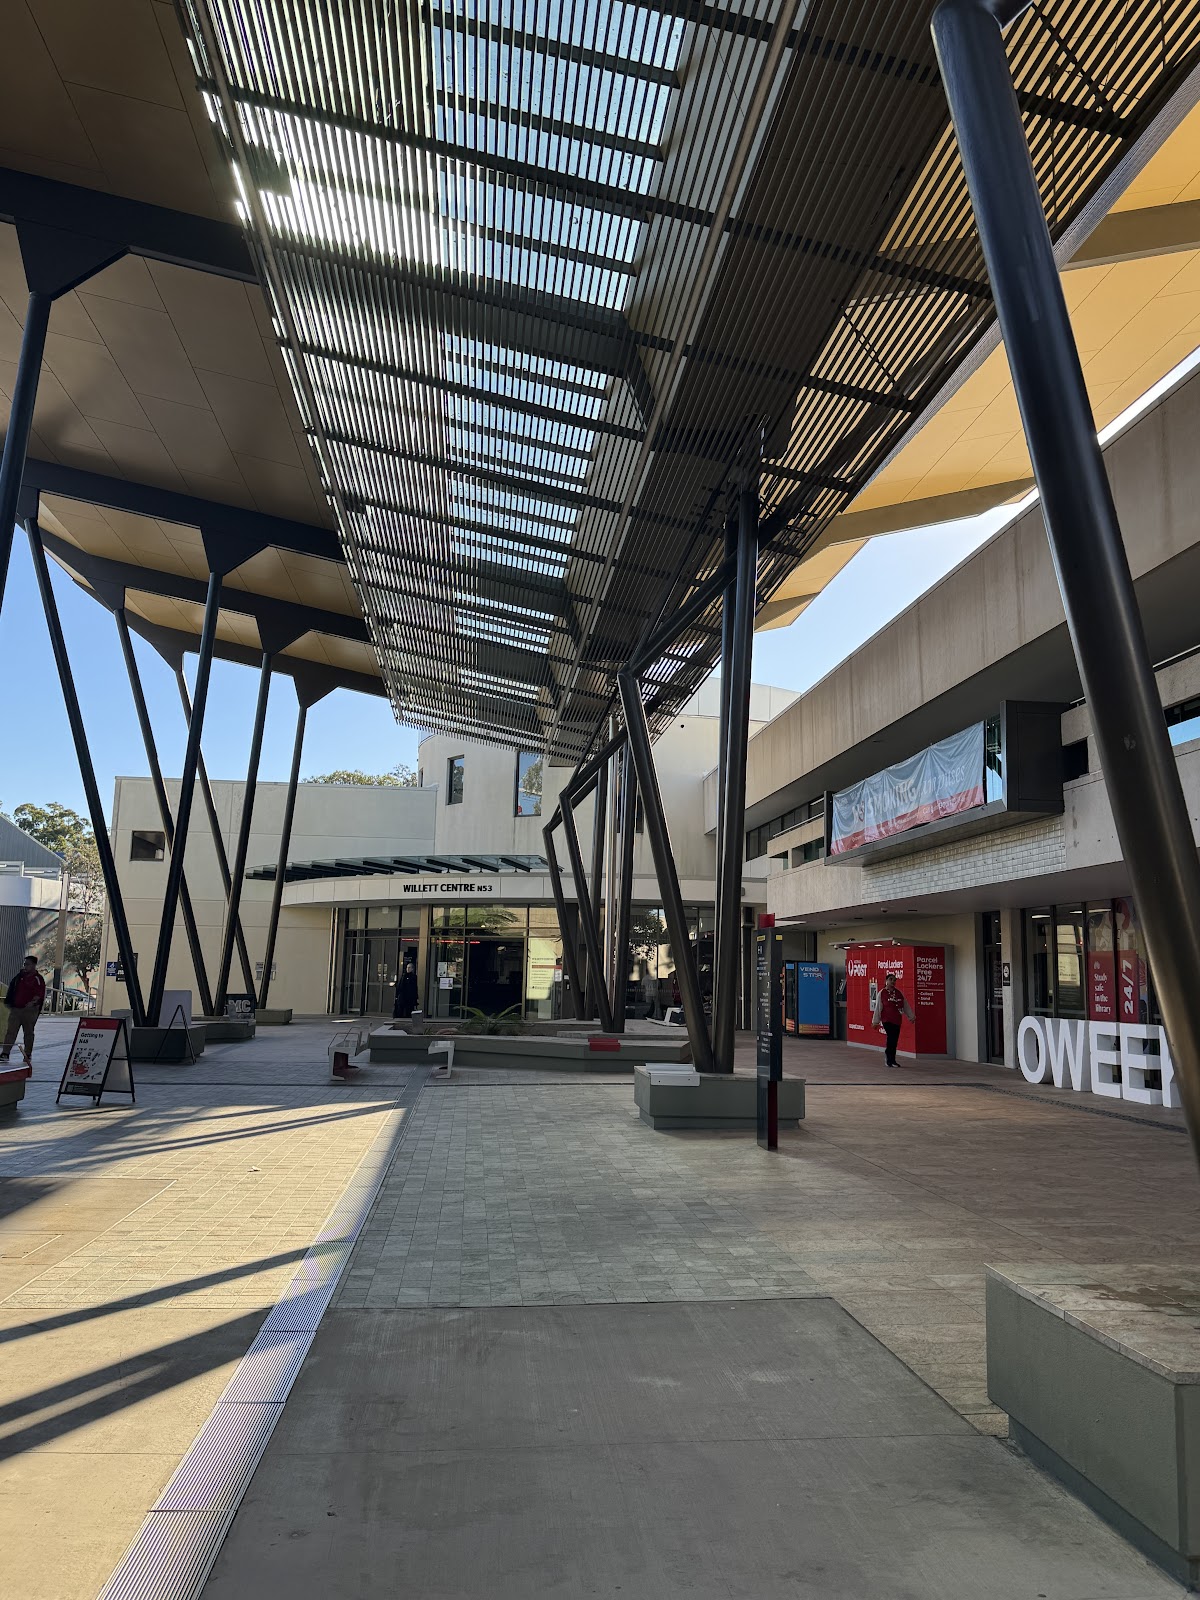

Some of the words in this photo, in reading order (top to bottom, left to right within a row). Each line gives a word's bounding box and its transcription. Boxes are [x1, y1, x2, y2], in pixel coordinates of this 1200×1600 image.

[403, 884, 439, 892] WILLETT
[440, 883, 476, 892] CENTRE
[878, 960, 888, 969] Parcel
[889, 960, 904, 969] Lockers
[853, 964, 867, 977] POST
[1094, 973, 1107, 984] Study
[1094, 983, 1105, 992] safe
[1121, 959, 1134, 1015] 24/7
[1095, 1003, 1111, 1015] library
